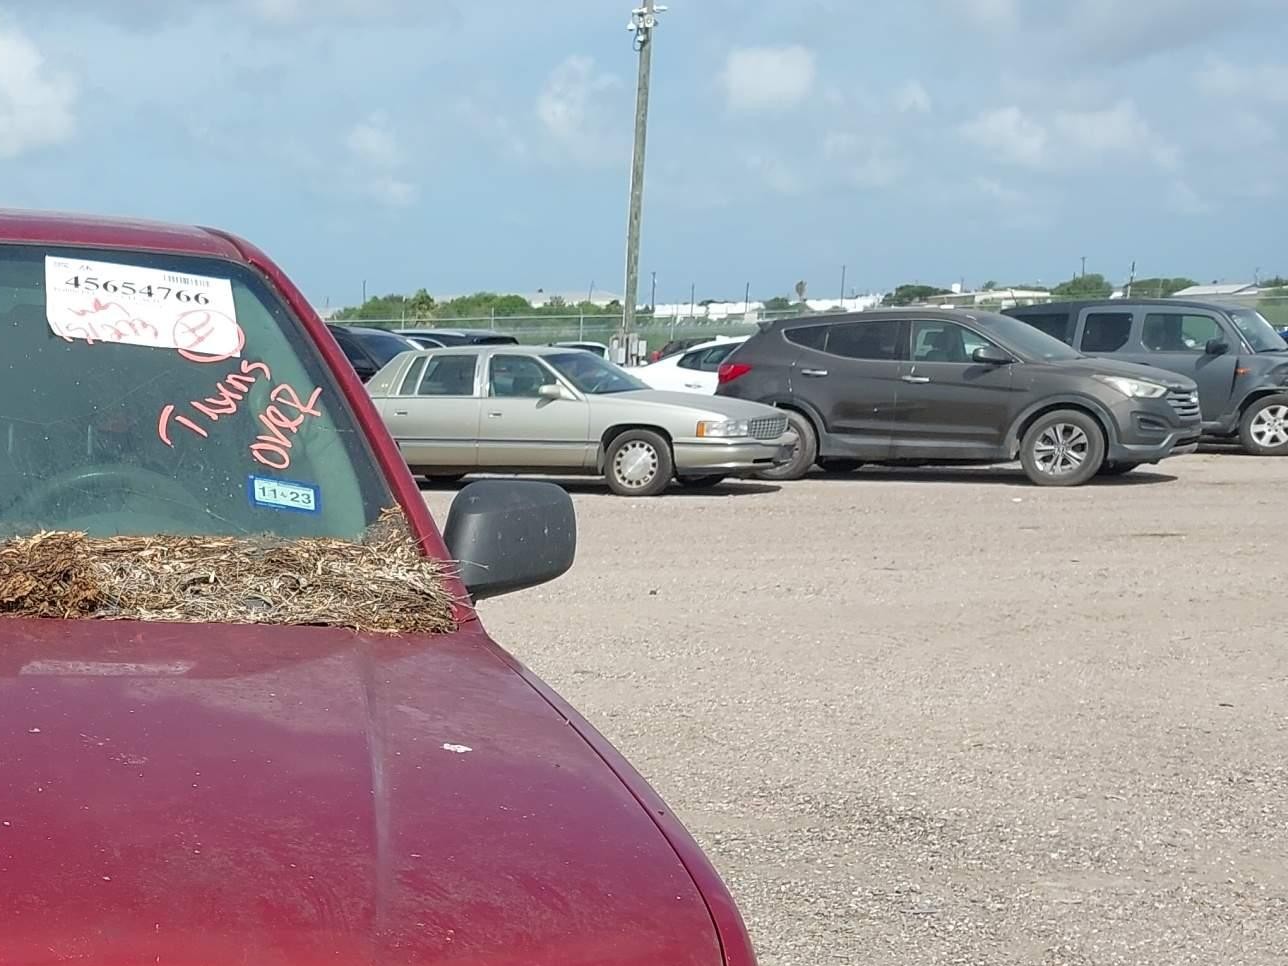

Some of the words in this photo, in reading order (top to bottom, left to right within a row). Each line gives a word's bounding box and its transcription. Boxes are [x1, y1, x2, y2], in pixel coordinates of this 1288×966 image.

[65, 275, 210, 305] 45654766
[258, 486, 277, 499] 11
[289, 491, 312, 505] 23
